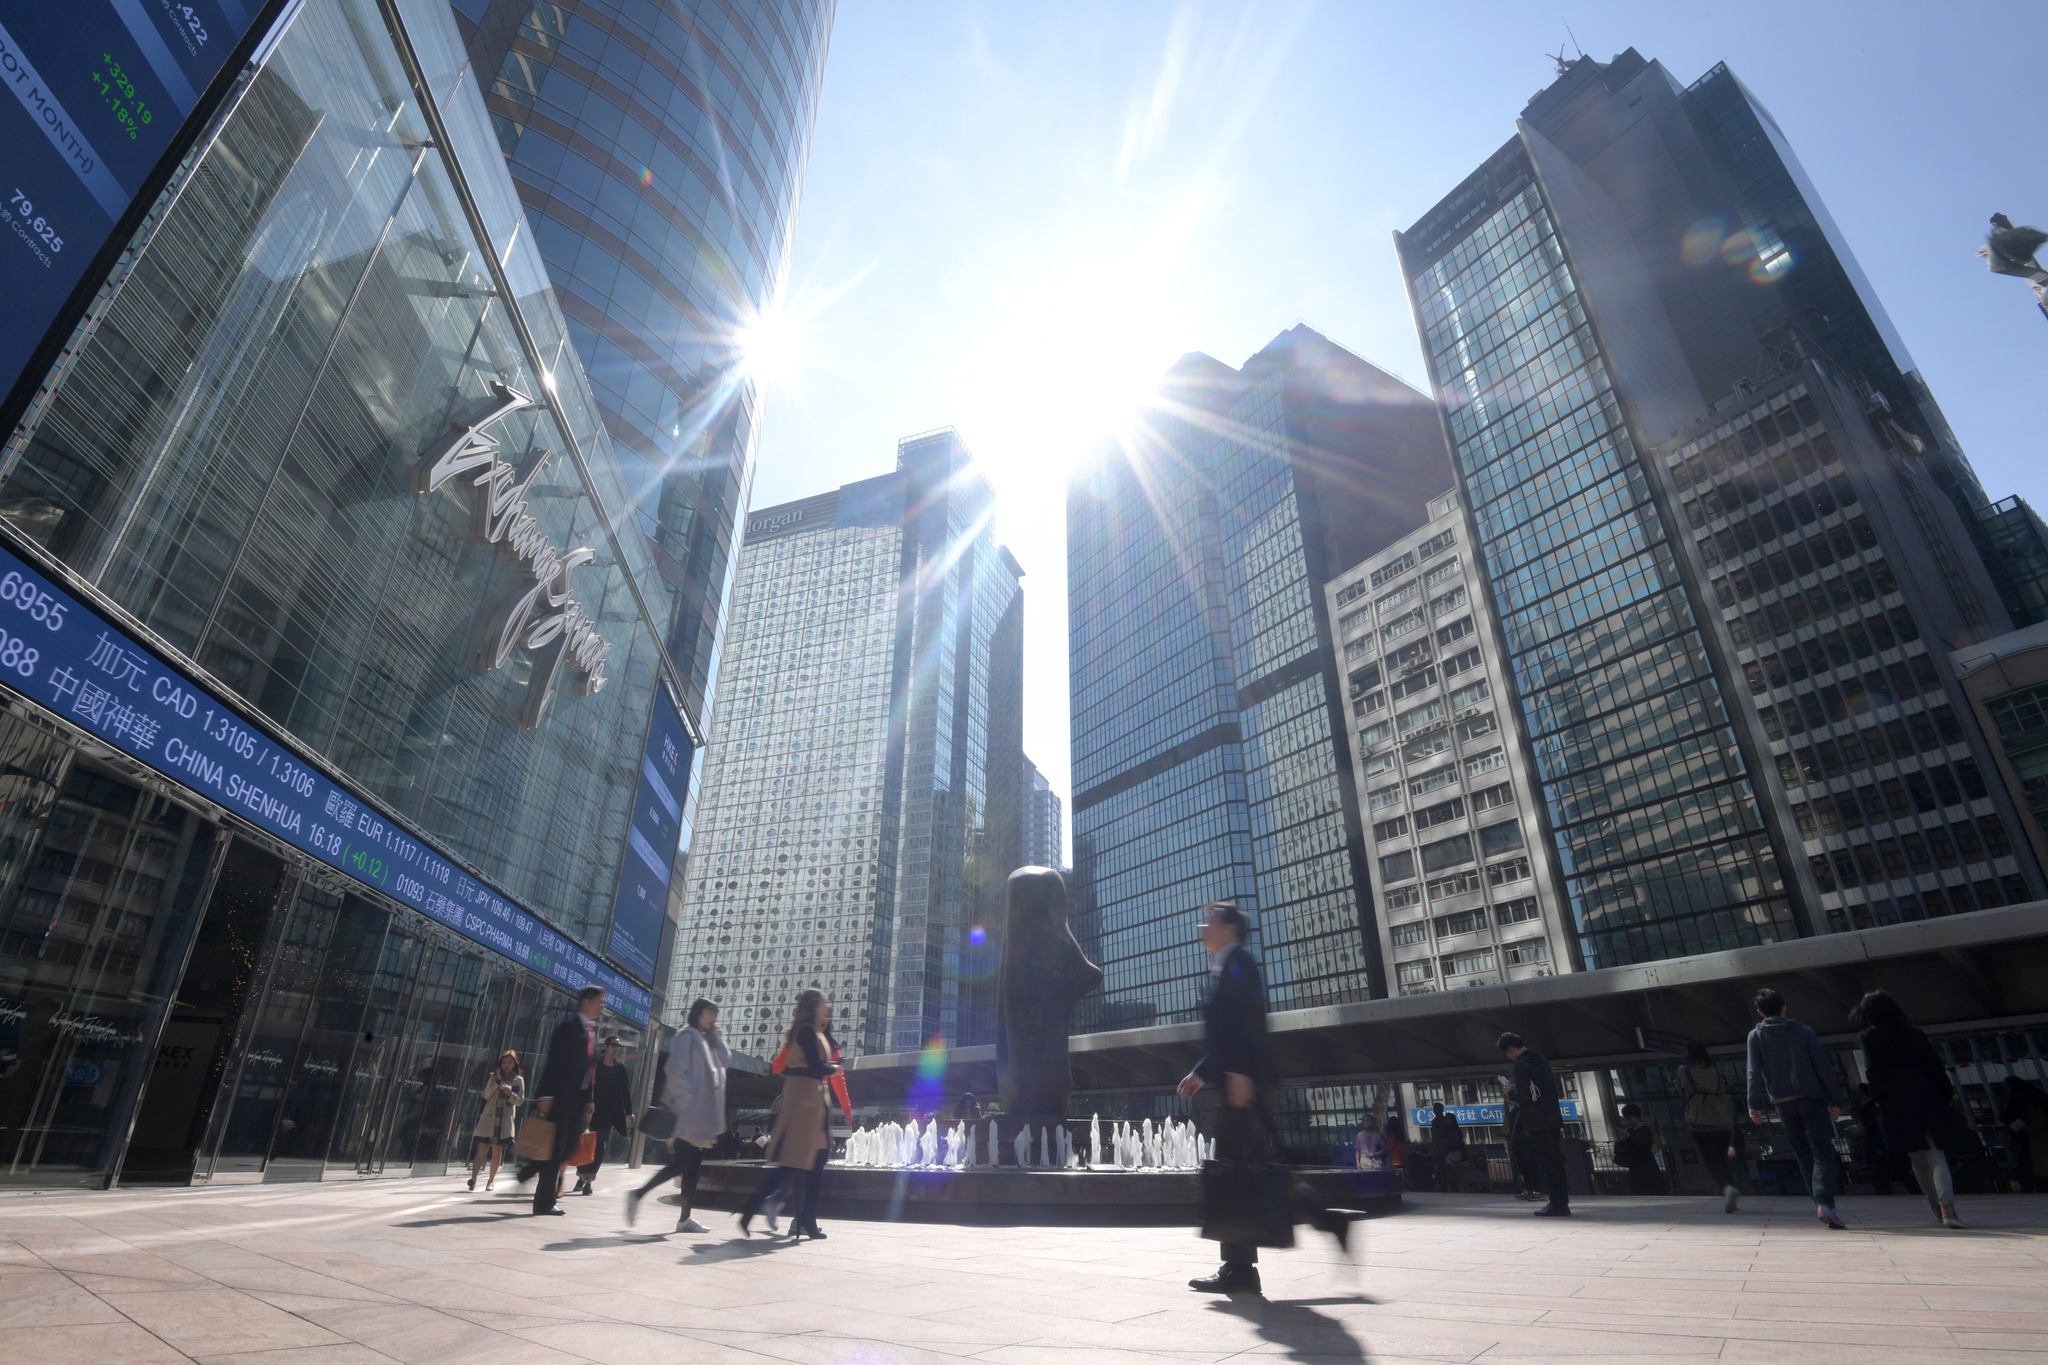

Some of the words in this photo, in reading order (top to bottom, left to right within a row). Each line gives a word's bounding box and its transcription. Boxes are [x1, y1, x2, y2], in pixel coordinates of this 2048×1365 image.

[169, 9, 197, 57] Contracts
[92, 71, 138, 140] +1.18%
[103, 52, 152, 125] +329.19
[28, 87, 94, 174] MONTH)
[10, 187, 64, 253] 79,625
[12, 221, 52, 268] Contracts
[0, 571, 68, 631] 6955
[85, 630, 148, 692] 加元
[152, 676, 197, 719] CAD
[203, 709, 258, 759] 1.3105
[269, 754, 315, 798] 1.3106
[325, 789, 358, 829] 歐羅
[357, 811, 384, 843] EUR
[385, 831, 417, 862] 1.1117
[422, 855, 451, 884] 1.1118
[456, 876, 476, 903] 日元
[475, 890, 491, 908] JPY
[490, 899, 512, 922] 109.46
[515, 914, 534, 934] 109.47
[554, 939, 567, 955] CNY
[48, 666, 162, 751] 中國神華
[164, 737, 223, 790] CHINA
[226, 774, 302, 835] SHENHUA
[308, 822, 342, 857] 16.18
[396, 873, 425, 902] 01093
[424, 889, 465, 928] 石藥集團
[465, 913, 487, 936] CSPC
[485, 924, 513, 951] PHARMA
[159, 1045, 195, 1059] KEX
